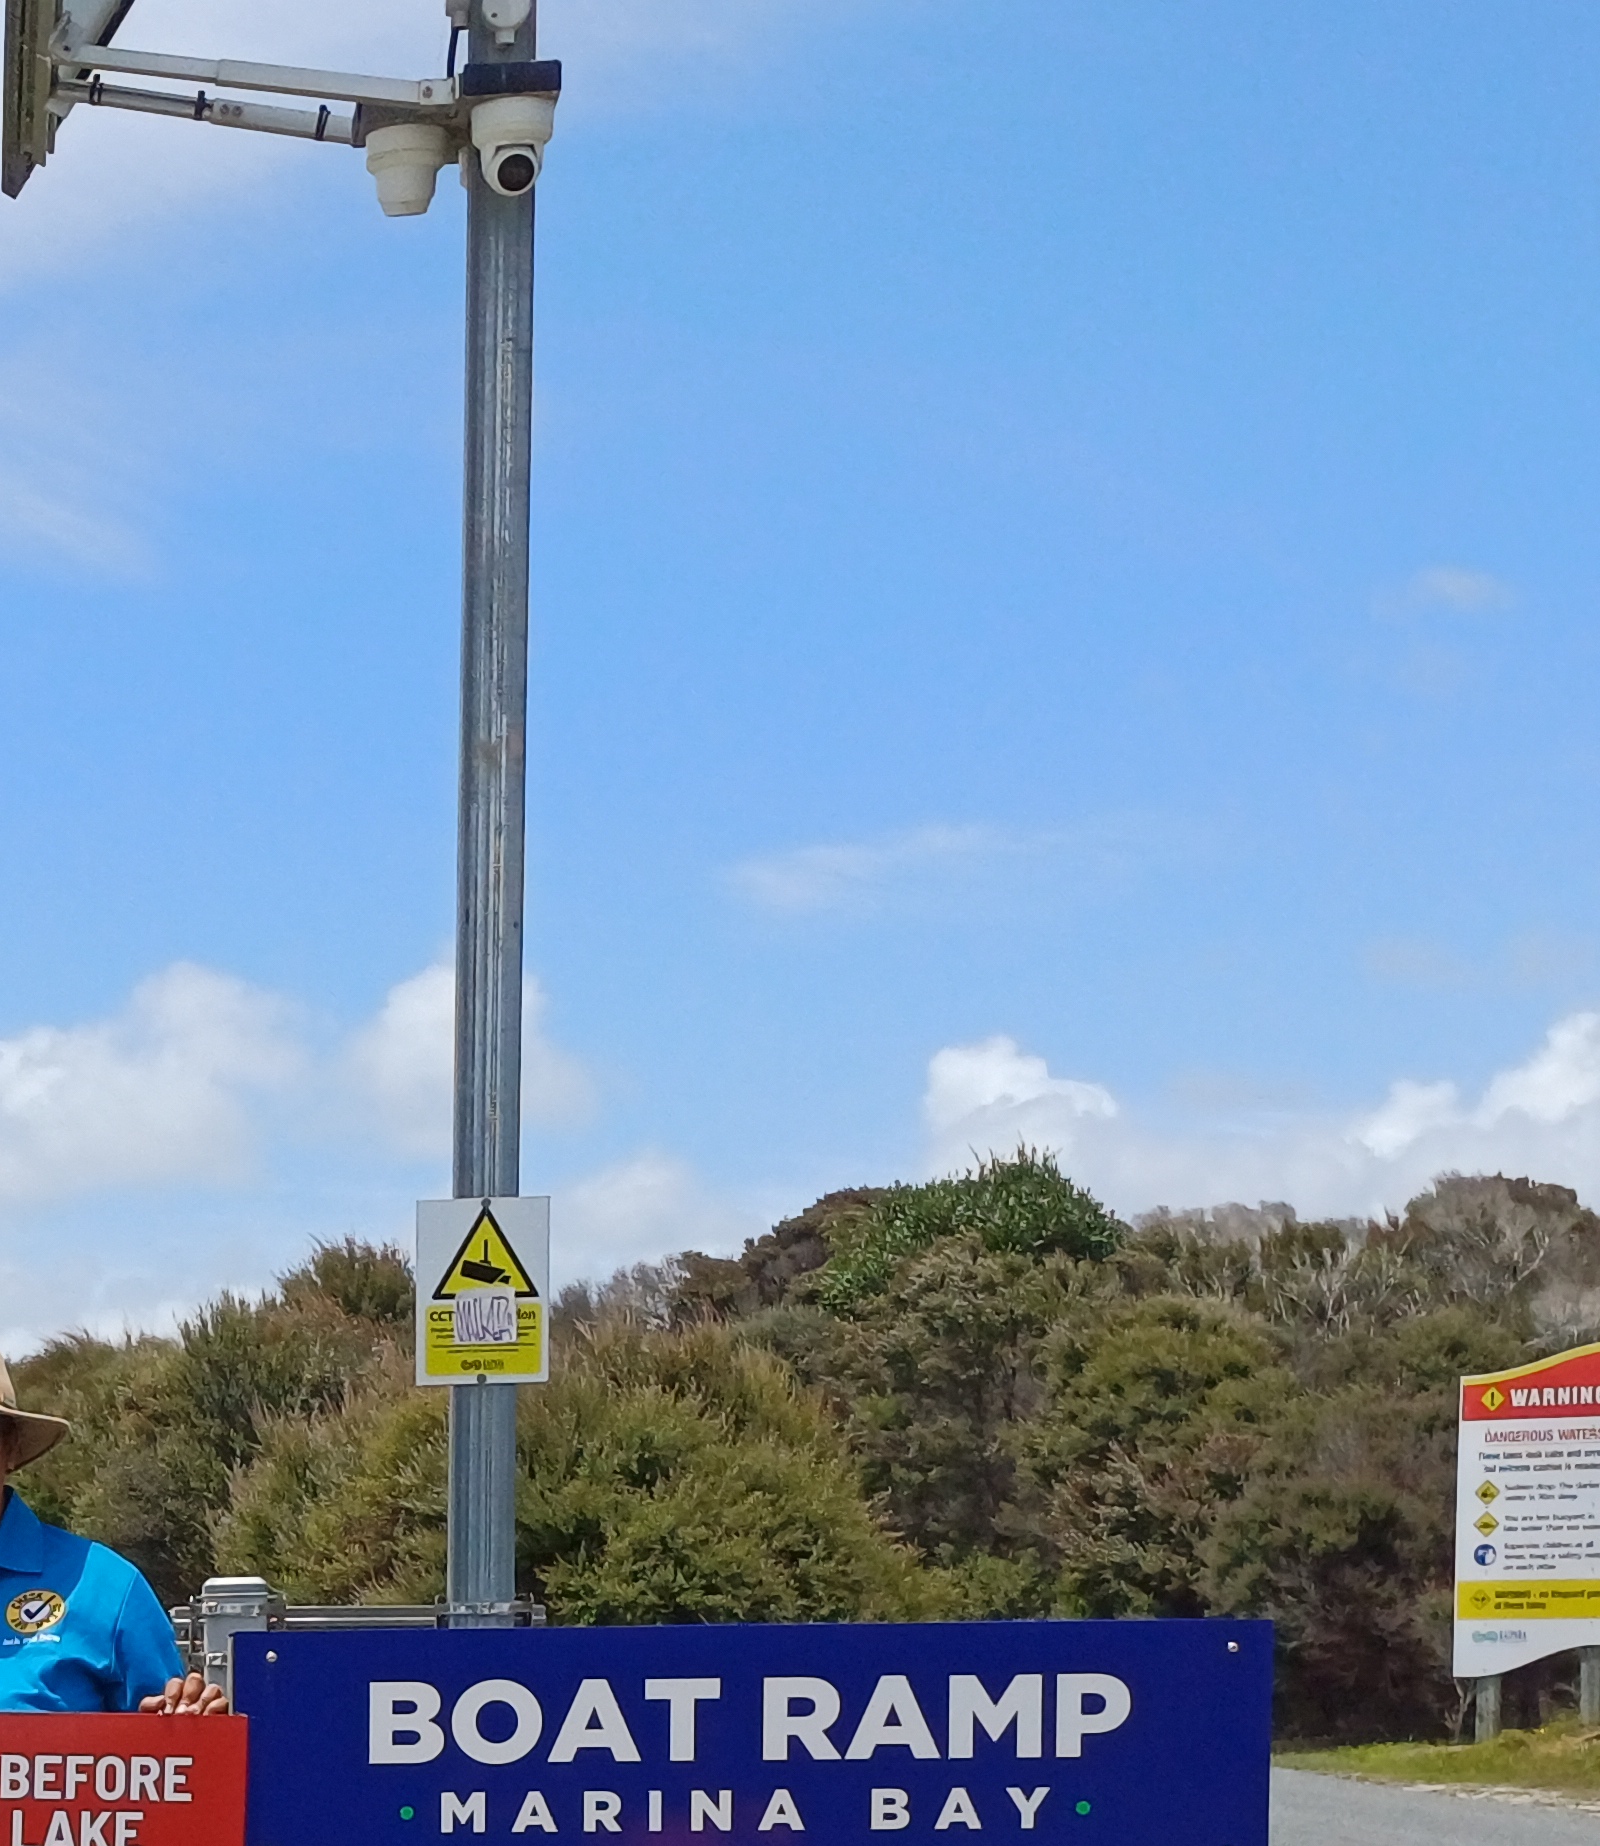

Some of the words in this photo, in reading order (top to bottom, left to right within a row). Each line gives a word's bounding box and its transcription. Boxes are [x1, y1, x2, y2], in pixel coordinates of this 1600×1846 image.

[430, 1310, 456, 1322] CCT
[1485, 1427, 1554, 1442] DANGEROUS
[368, 1675, 722, 1765] BOAT
[763, 1673, 1133, 1761] RAMP
[440, 1788, 806, 1834] MARINA
[870, 1786, 1051, 1830] BAY
